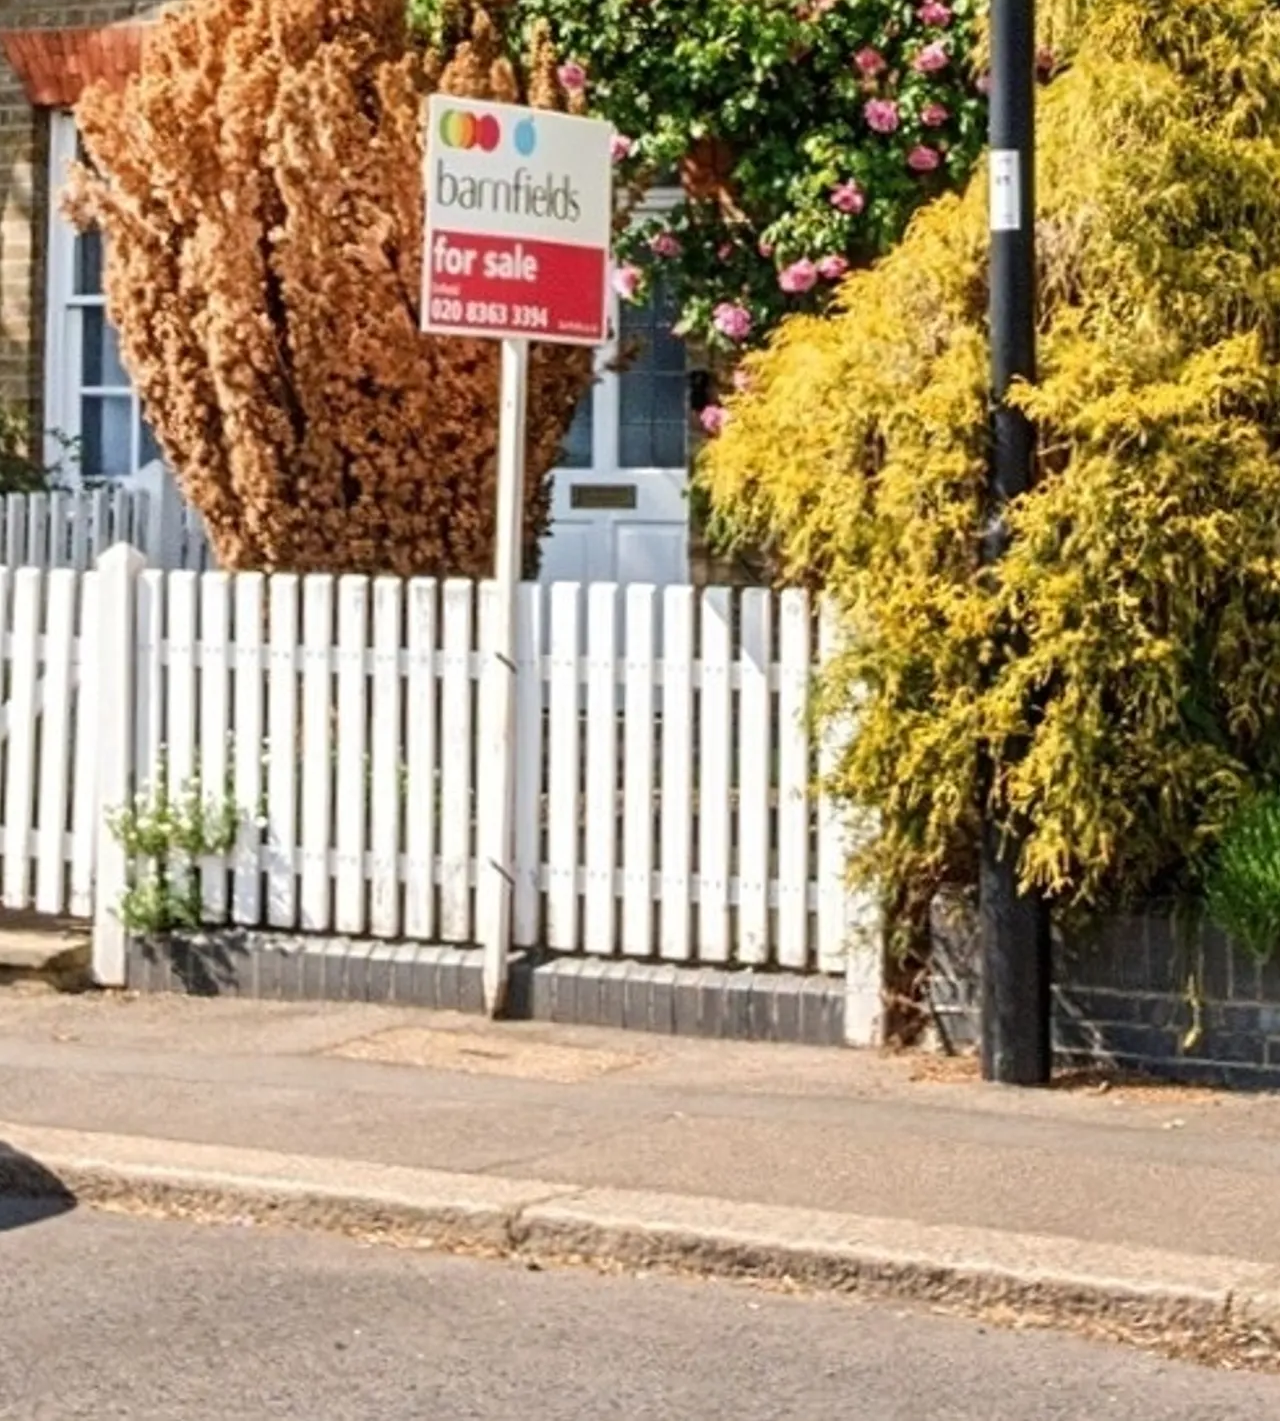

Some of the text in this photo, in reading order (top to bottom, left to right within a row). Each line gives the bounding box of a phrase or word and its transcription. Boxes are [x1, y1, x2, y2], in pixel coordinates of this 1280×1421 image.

[437, 159, 581, 223] barnfields
[433, 236, 539, 282] for sale
[431, 297, 462, 323] 020
[511, 306, 548, 329] 3394
